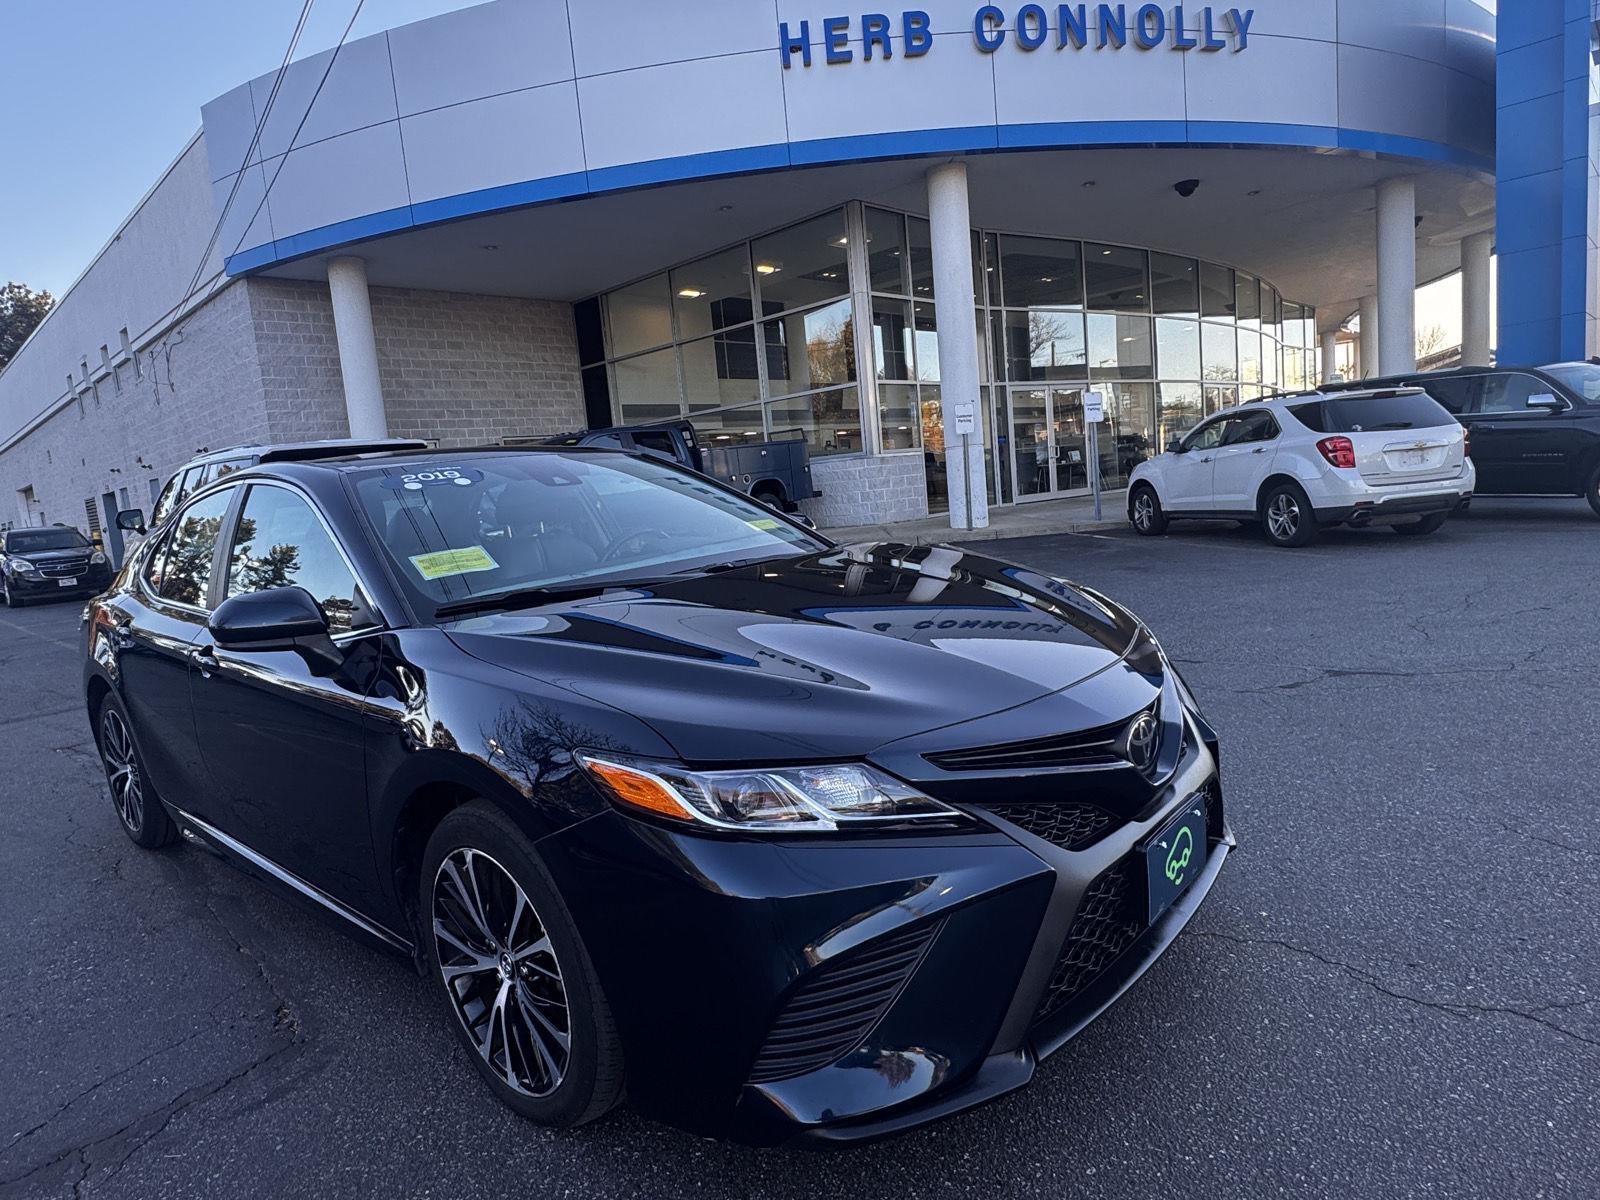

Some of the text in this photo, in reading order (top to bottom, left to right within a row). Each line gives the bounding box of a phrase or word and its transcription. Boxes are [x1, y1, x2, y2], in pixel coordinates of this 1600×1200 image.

[779, 2, 1255, 69] HERB CONNOLLY
[400, 470, 461, 483] 2019
